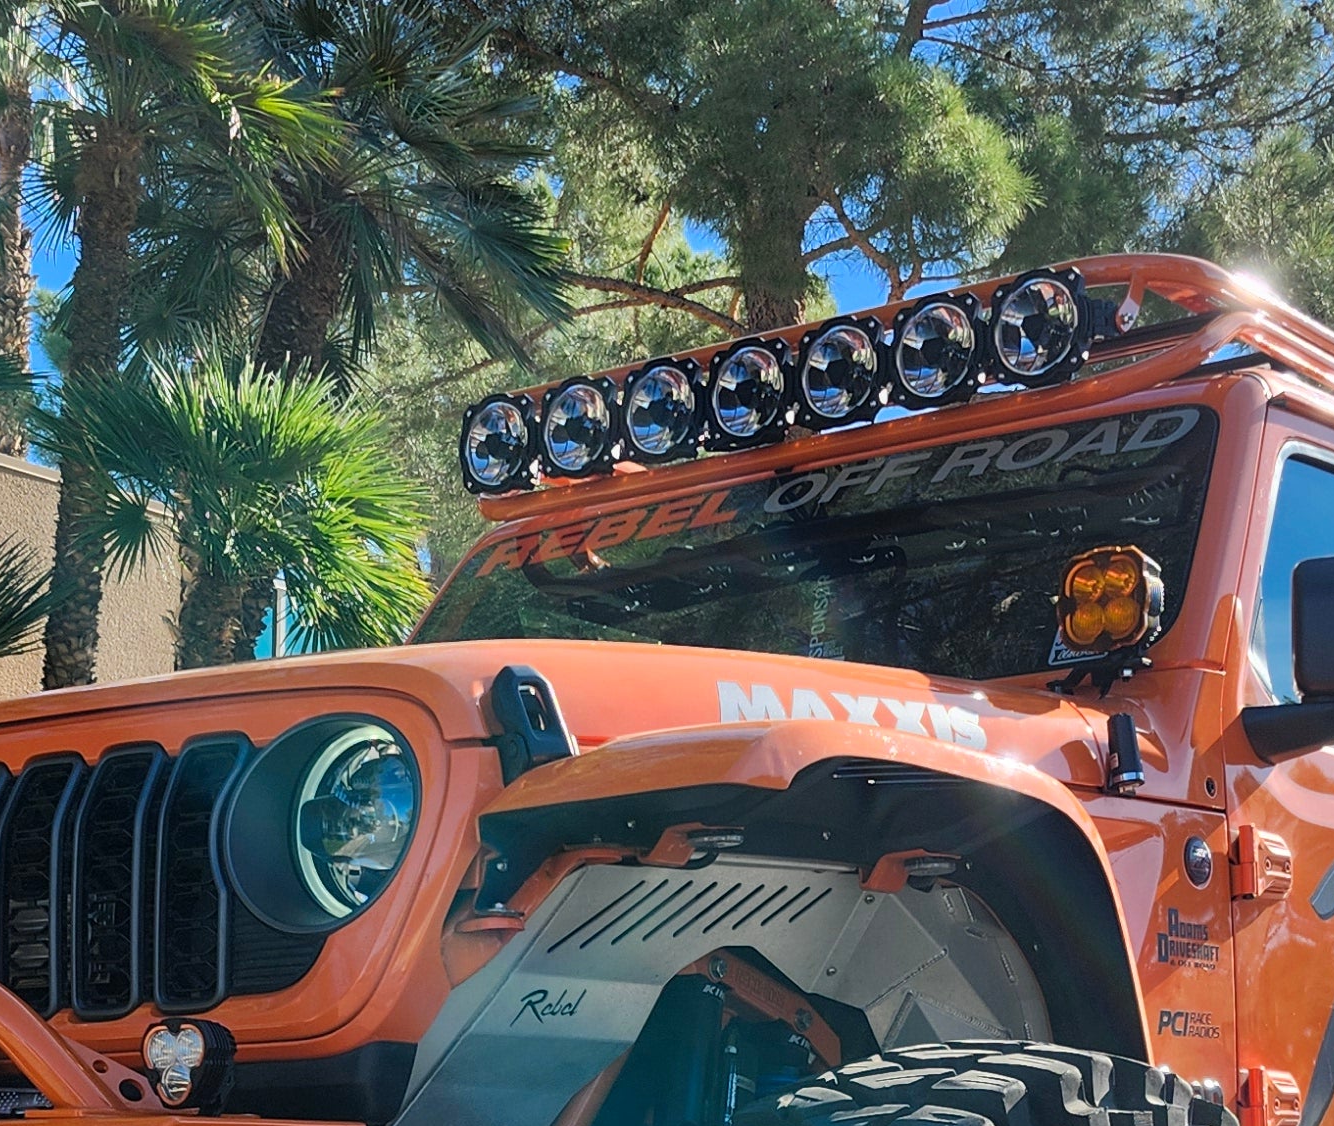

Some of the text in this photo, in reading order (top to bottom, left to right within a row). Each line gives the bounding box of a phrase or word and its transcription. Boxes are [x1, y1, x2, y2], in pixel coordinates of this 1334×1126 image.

[475, 408, 1201, 577] REBEL OFF ROAD
[717, 680, 987, 751] MAXXIS
[510, 989, 587, 1027] Rebel
[1158, 1010, 1212, 1037] PCI RACE
[1189, 1026, 1220, 1039] RADIOS
